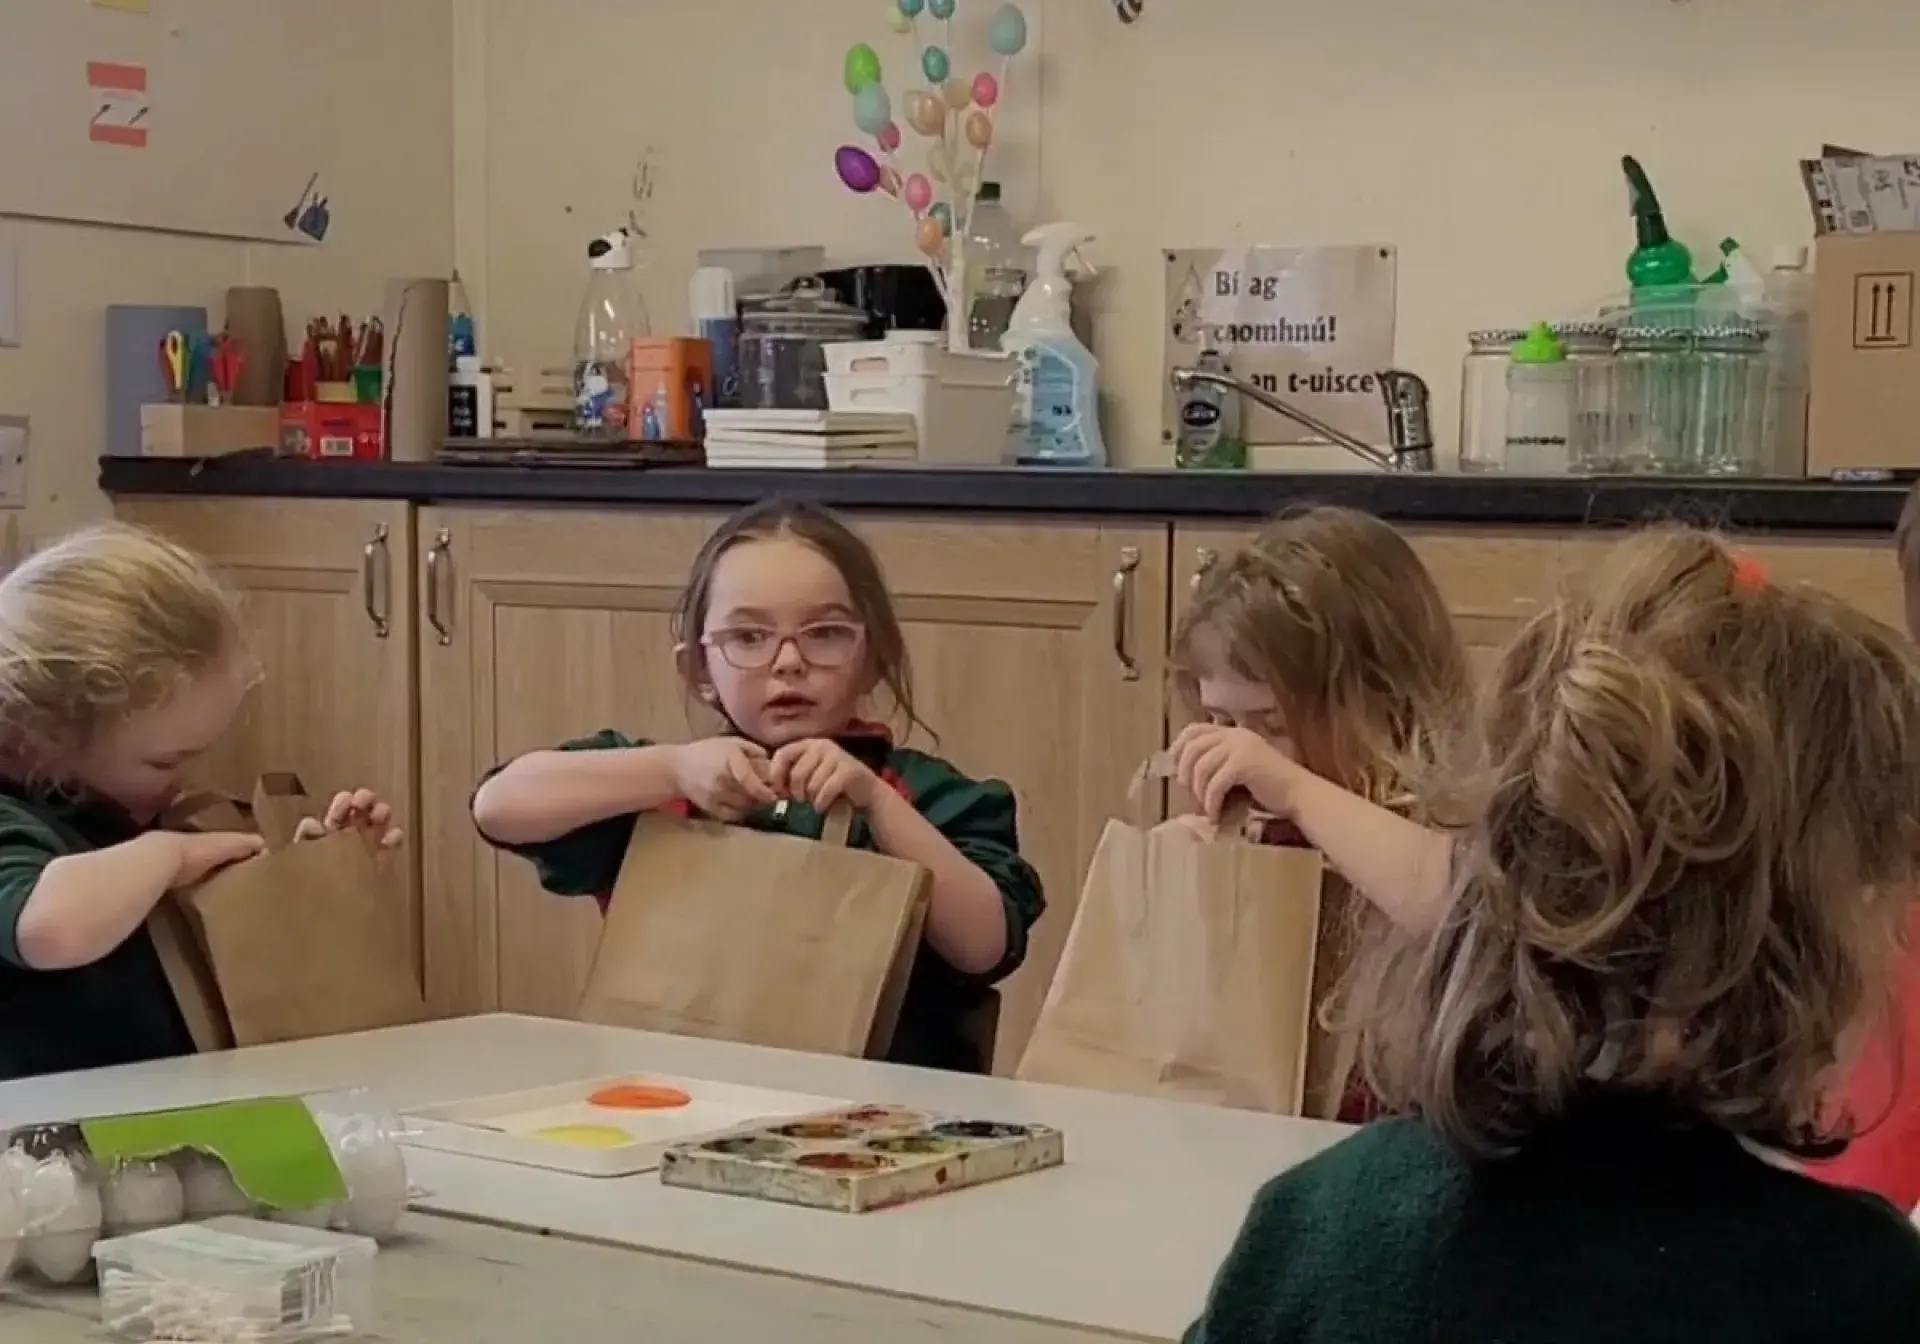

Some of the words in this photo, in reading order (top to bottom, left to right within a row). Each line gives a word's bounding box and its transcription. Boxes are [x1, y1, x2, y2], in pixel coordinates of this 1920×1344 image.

[1216, 271, 1239, 296] Bí
[1249, 276, 1279, 301] ag
[1213, 316, 1337, 343] caomhnú!
[1288, 366, 1374, 393] t-uisce
